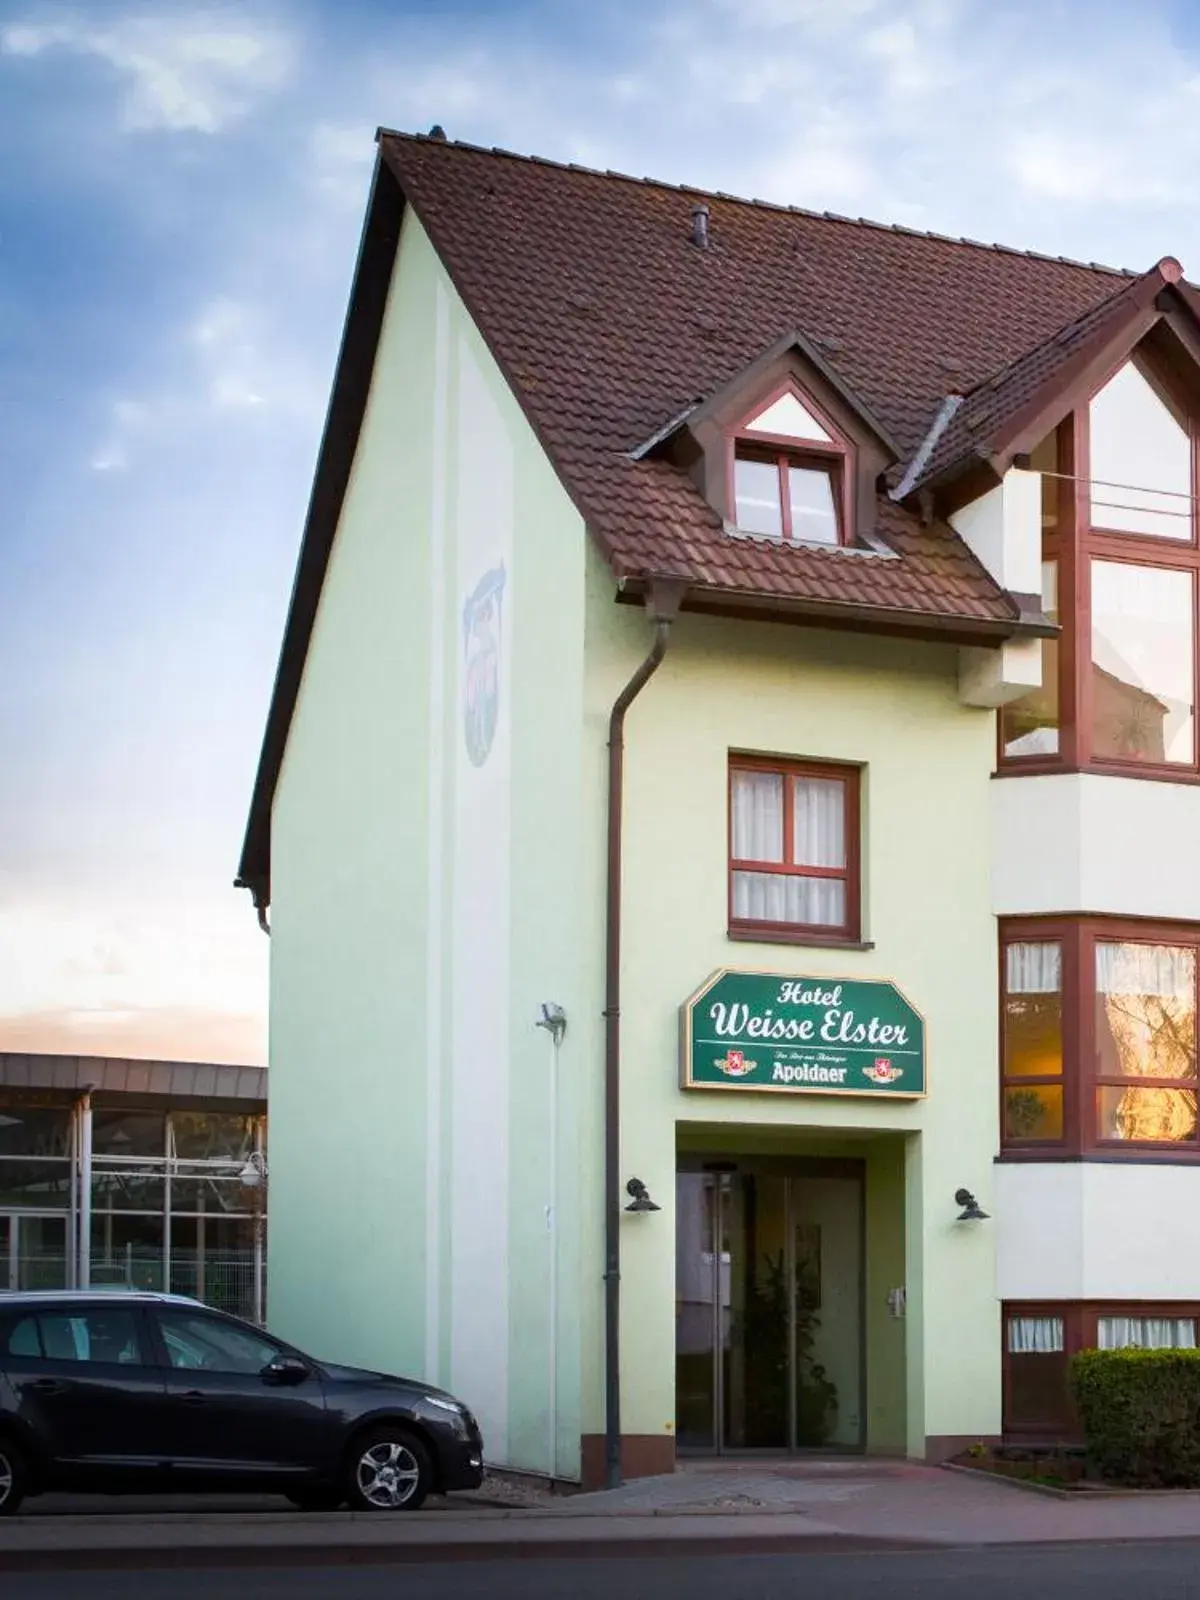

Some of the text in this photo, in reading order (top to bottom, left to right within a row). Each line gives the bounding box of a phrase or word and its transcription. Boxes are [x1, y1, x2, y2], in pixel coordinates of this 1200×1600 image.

[777, 982, 843, 1006] Hotel
[710, 1003, 909, 1045] Weisse Elster
[772, 1062, 847, 1083] Apoldaer
